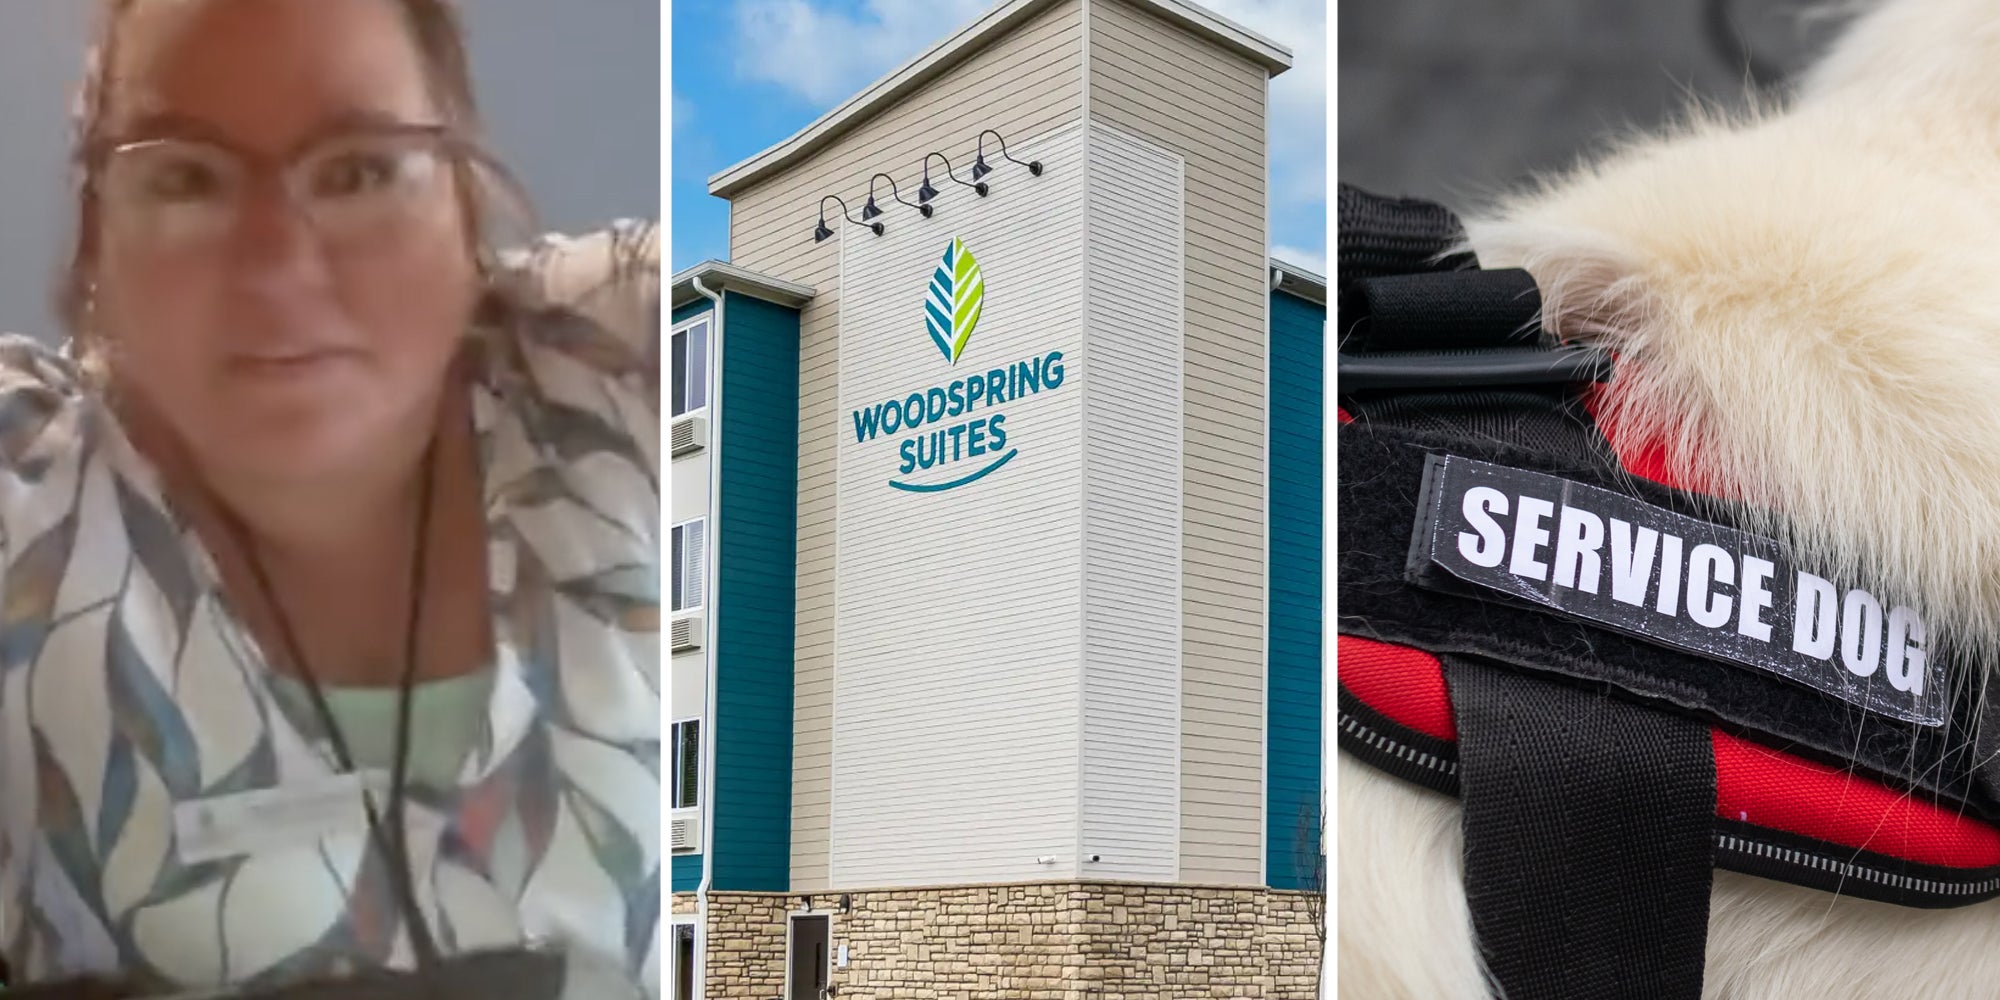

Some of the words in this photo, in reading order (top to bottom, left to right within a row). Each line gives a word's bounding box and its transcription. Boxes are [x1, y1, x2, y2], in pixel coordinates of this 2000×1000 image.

[853, 351, 1064, 443] WOODSPRING
[899, 414, 1006, 474] SUITES
[1458, 486, 1775, 643] SERVICE
[1792, 571, 1926, 696] DOG
